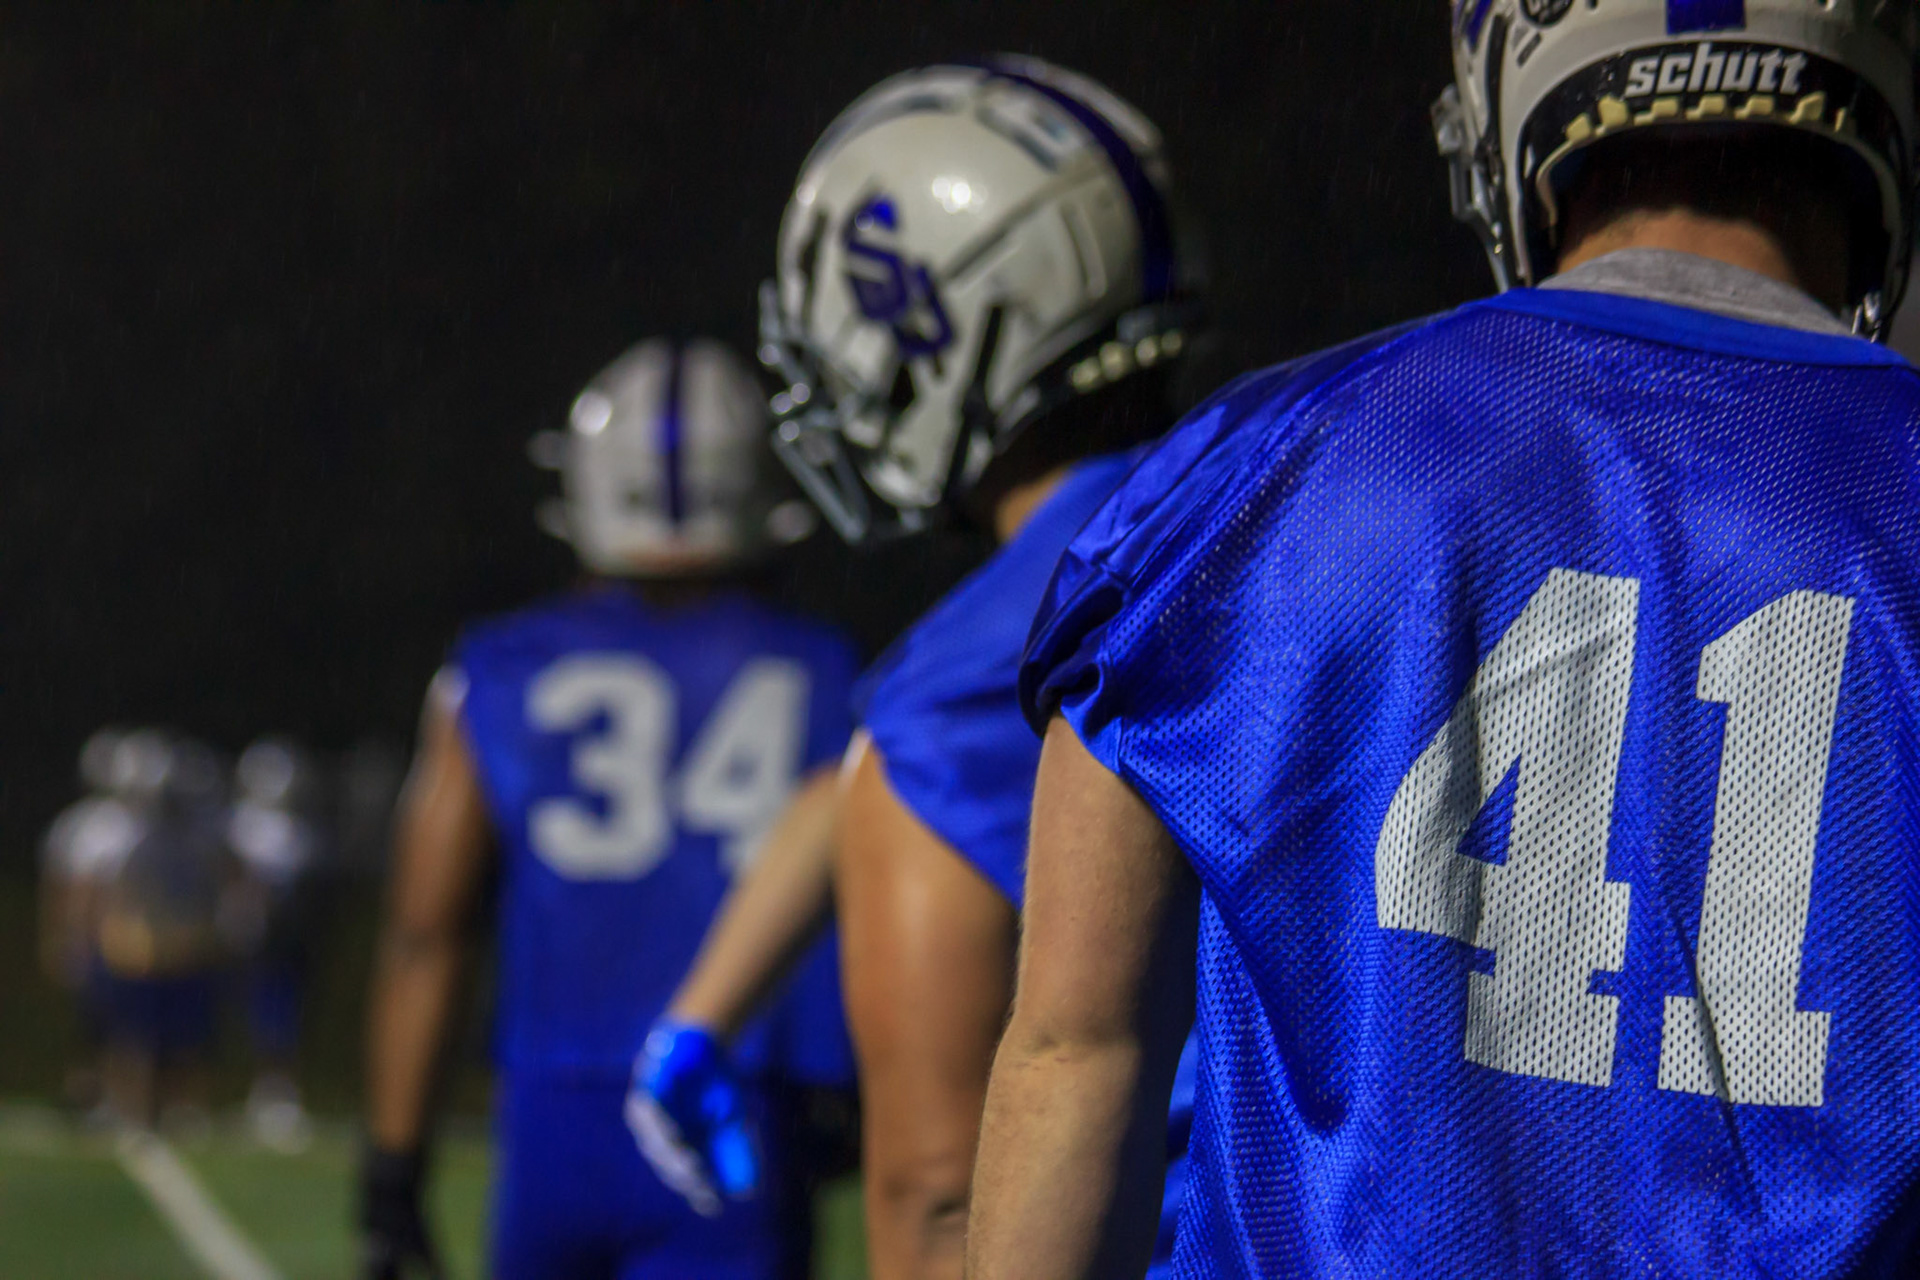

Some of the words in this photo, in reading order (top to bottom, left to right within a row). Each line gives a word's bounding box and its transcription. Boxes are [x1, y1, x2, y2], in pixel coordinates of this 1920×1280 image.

[1625, 42, 1807, 98] schutt
[523, 650, 811, 880] 34
[1374, 566, 1856, 1107] 41
